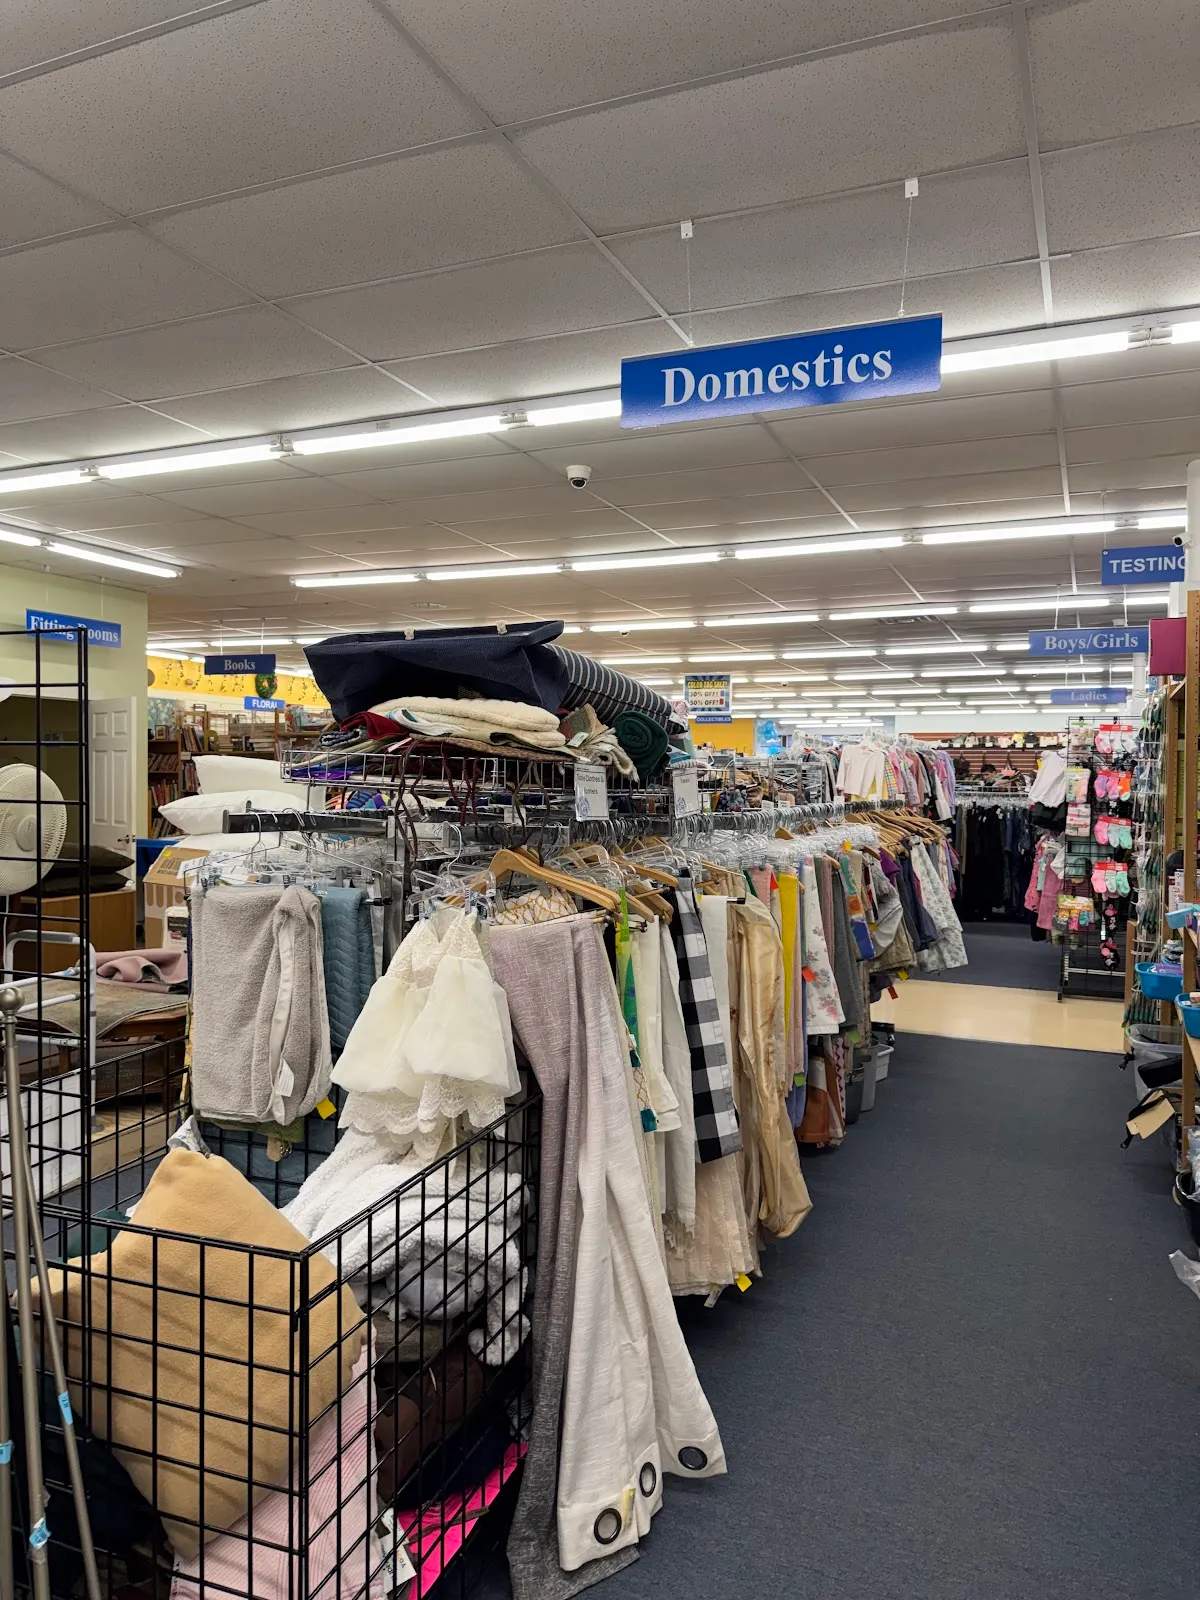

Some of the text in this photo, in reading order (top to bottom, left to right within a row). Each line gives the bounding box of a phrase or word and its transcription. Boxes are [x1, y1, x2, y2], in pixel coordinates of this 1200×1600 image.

[661, 344, 893, 408] Domestics
[78, 623, 119, 642] ooms
[1045, 633, 1139, 653] Boys/Girls
[224, 659, 256, 671] Books
[1071, 691, 1107, 701] Ladies
